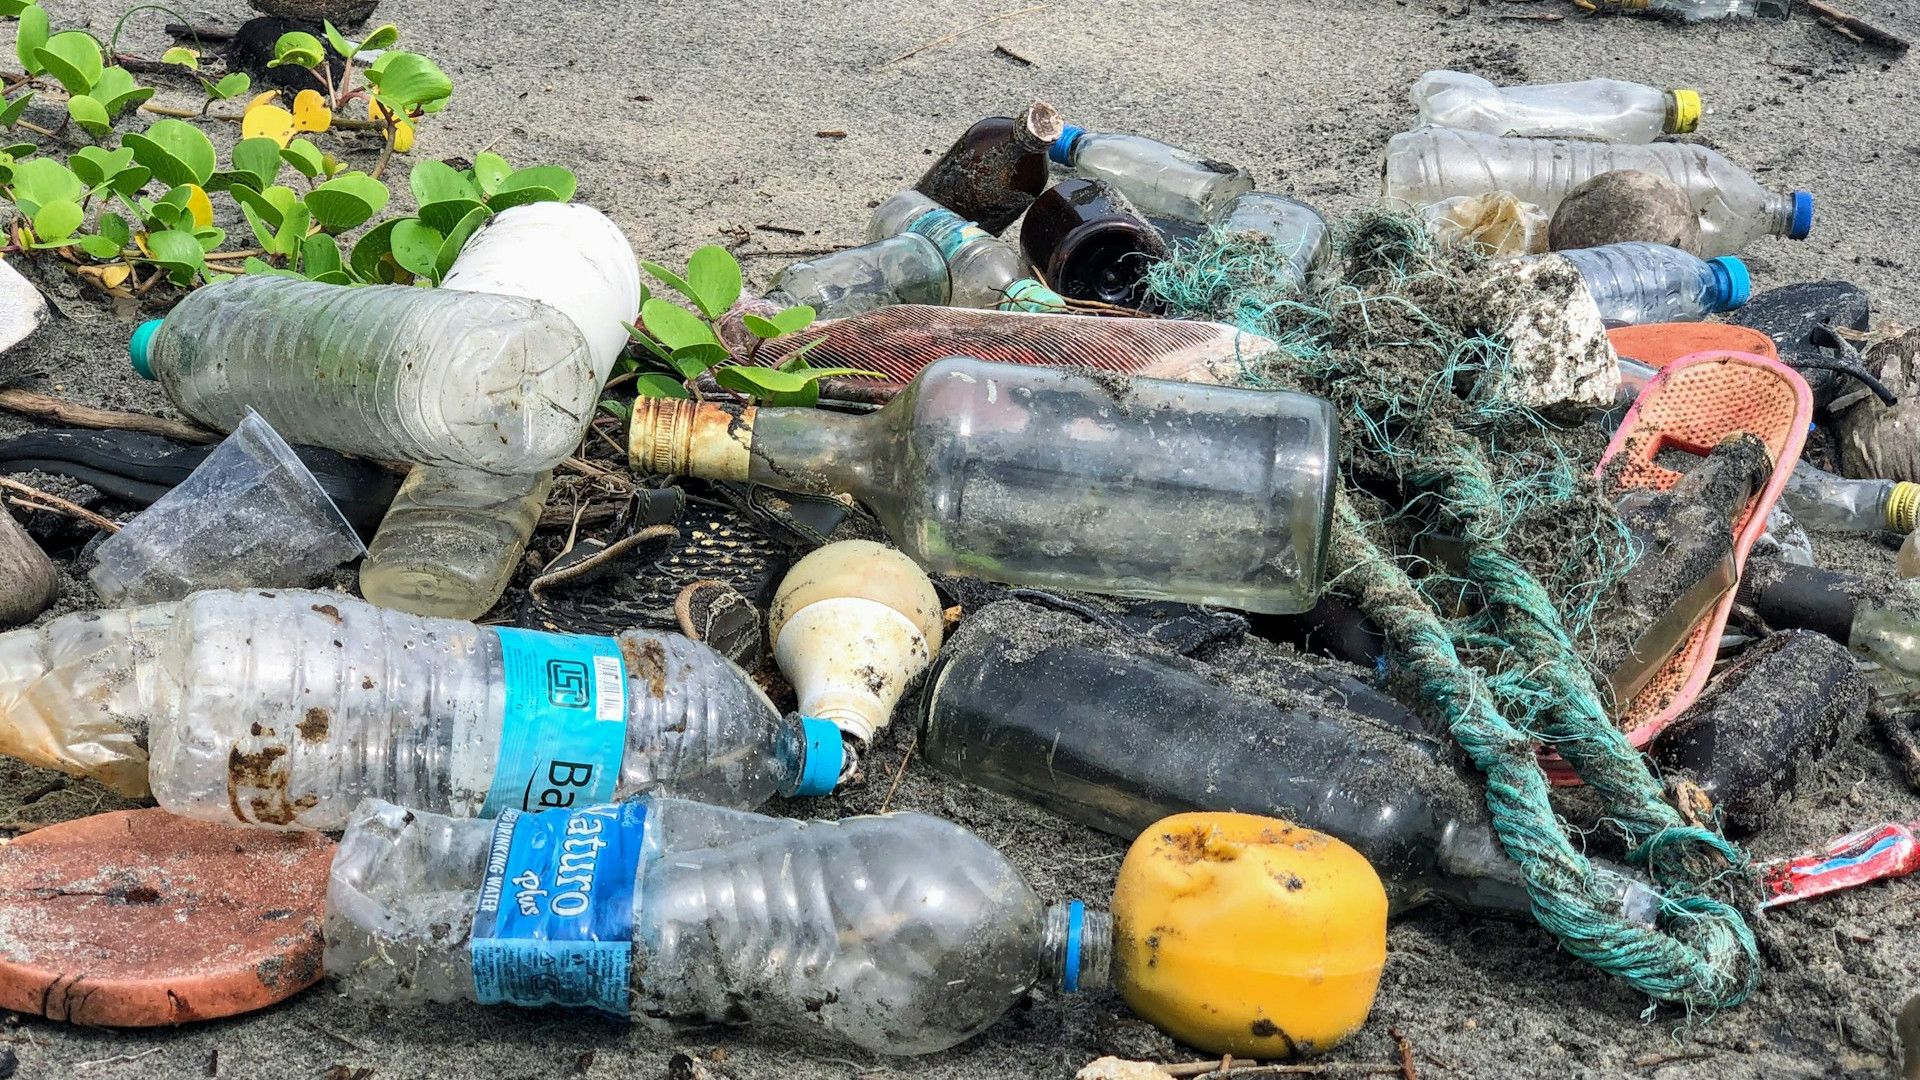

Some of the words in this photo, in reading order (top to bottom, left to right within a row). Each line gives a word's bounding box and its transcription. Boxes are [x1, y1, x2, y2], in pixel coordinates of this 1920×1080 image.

[538, 760, 593, 811] Ba
[489, 822, 515, 875] DRINKING
[480, 876, 503, 912] WATER
